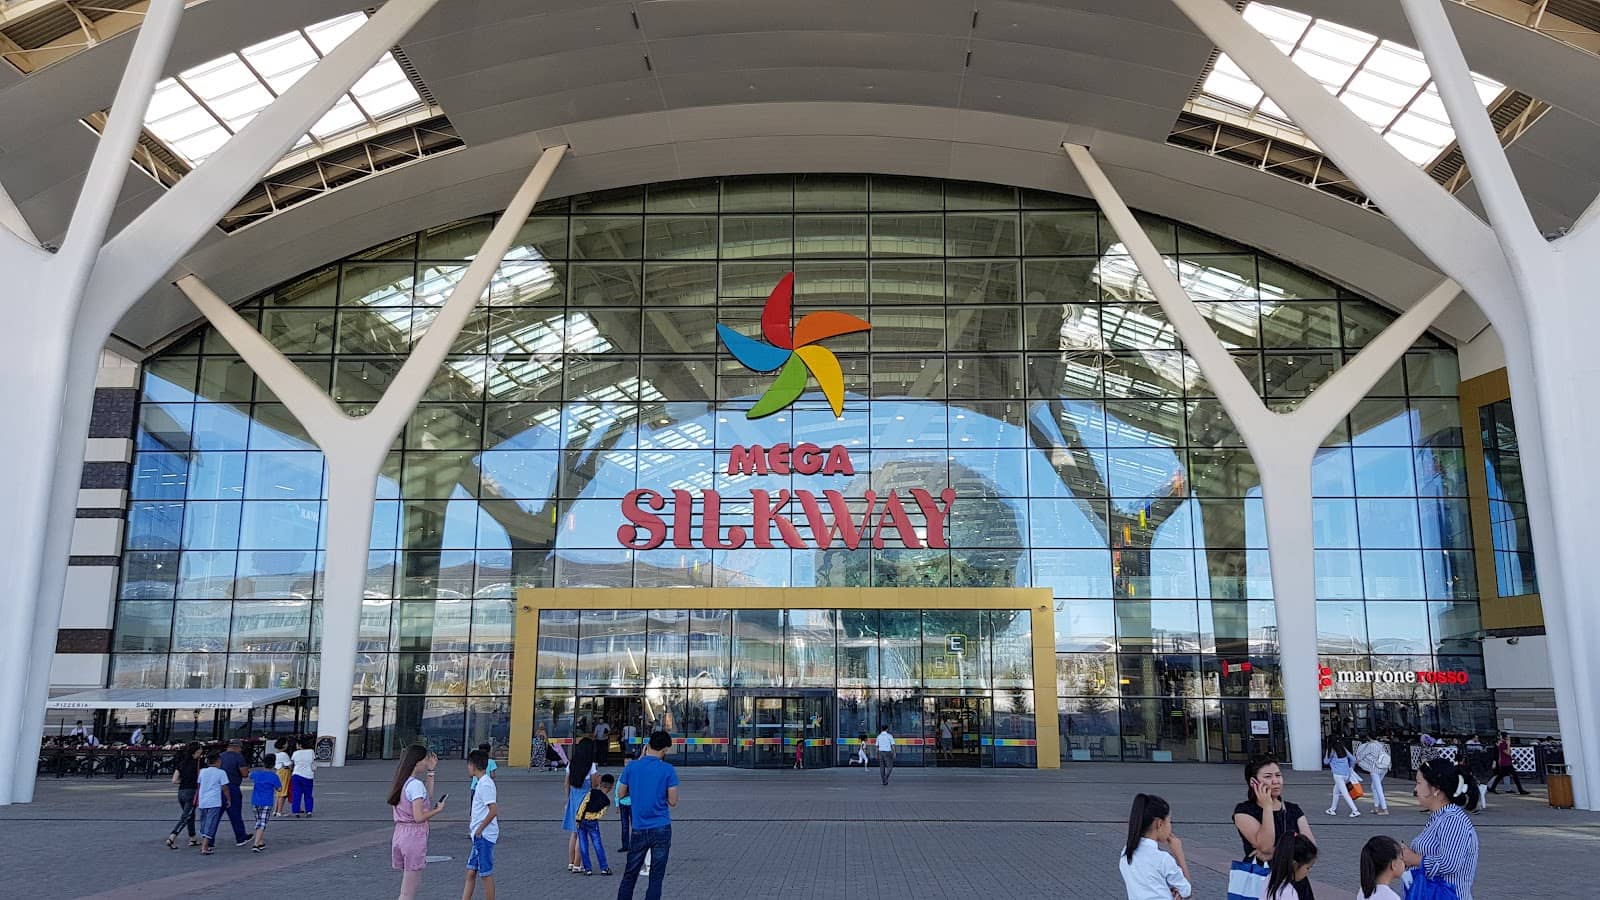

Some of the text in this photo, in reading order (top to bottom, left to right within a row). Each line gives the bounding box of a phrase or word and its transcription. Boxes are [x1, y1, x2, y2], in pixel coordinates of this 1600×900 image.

[728, 443, 855, 475] MEGA
[617, 488, 956, 550] SILKWAY
[415, 664, 439, 672] SADU
